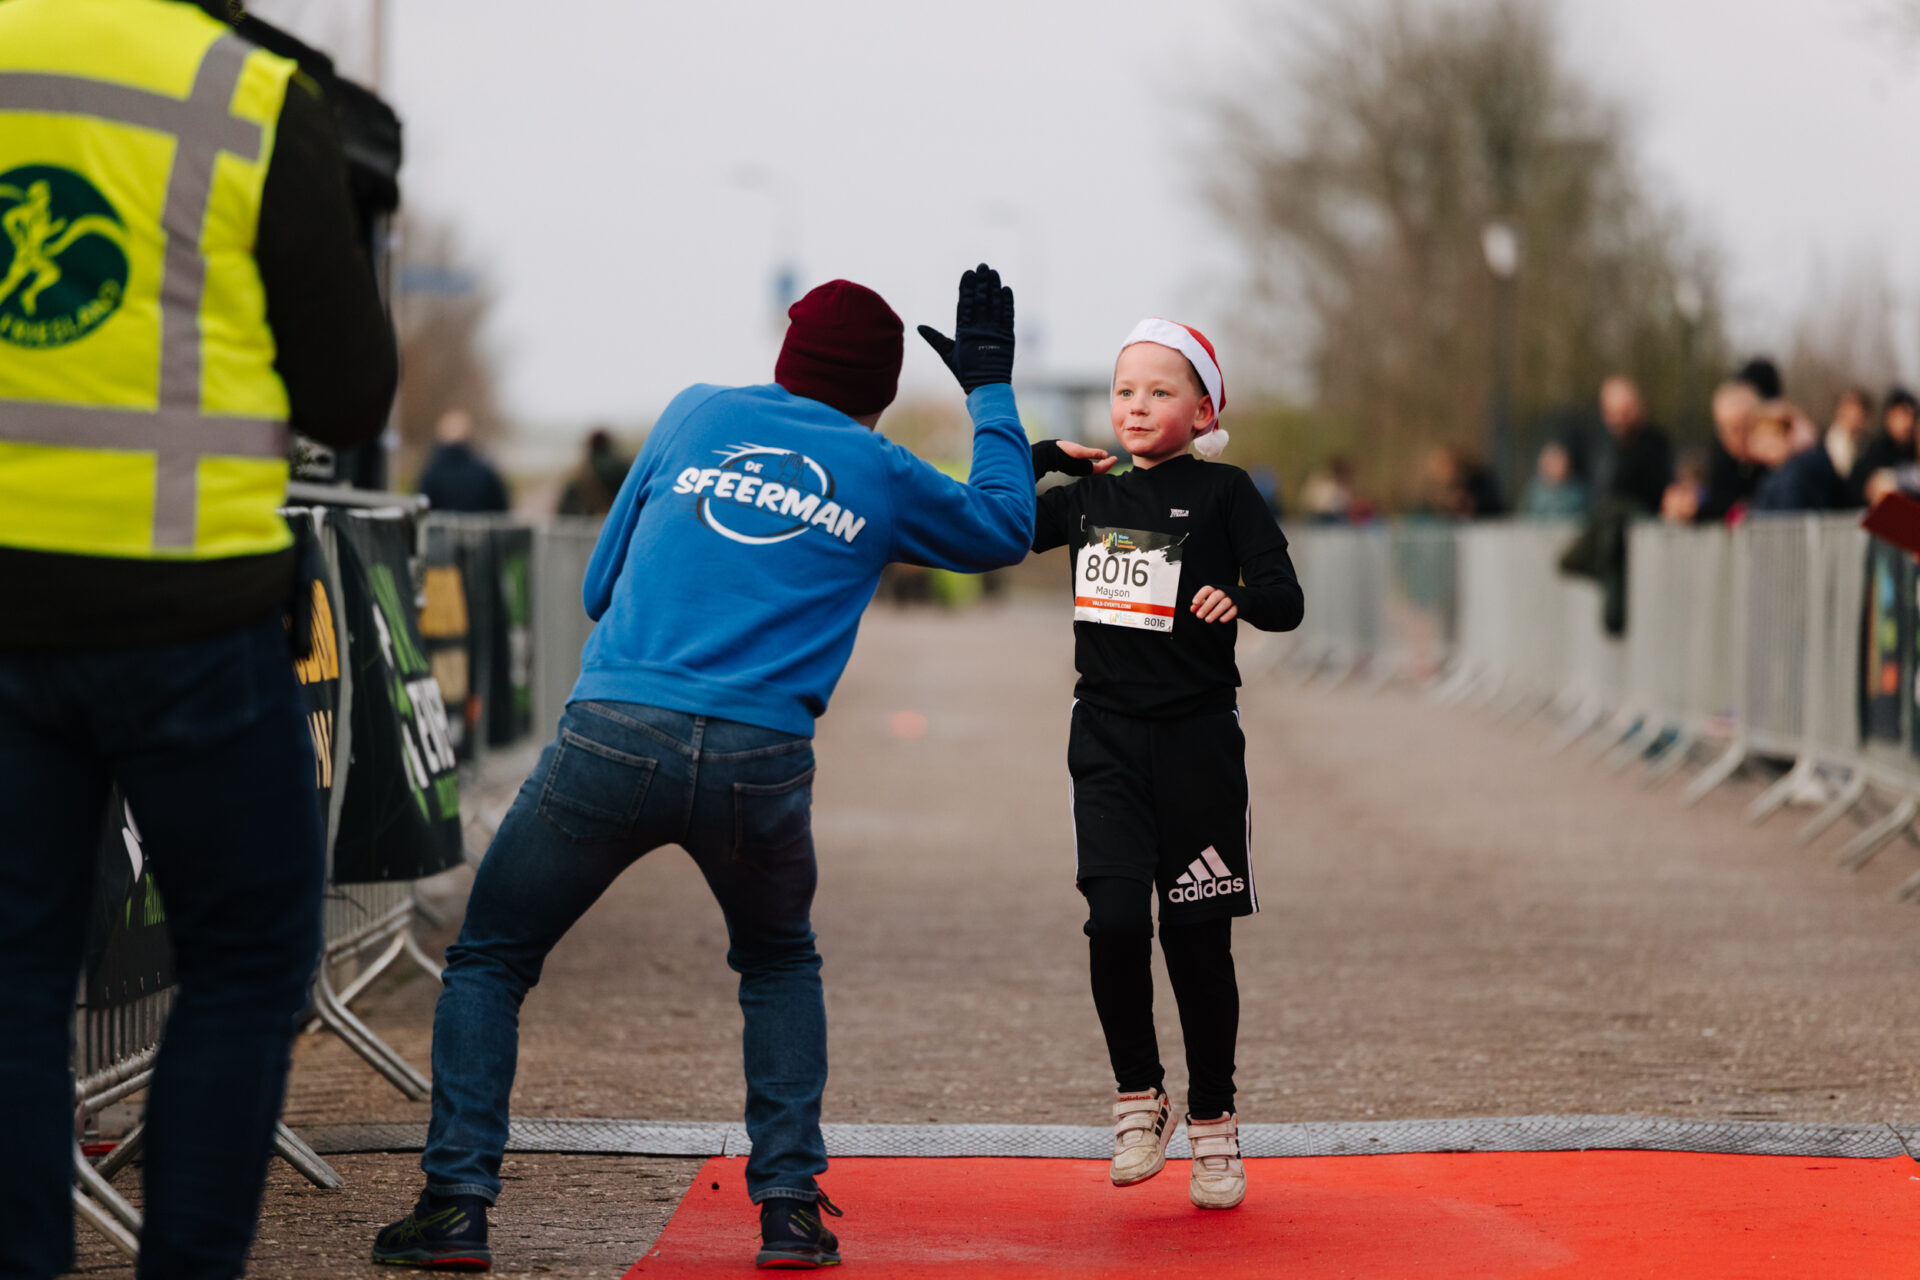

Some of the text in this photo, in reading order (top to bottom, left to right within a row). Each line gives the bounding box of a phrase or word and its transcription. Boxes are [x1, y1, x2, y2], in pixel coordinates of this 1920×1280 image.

[744, 461, 763, 473] DE
[672, 467, 866, 543] SFEERMAN
[1085, 554, 1150, 587] 8016
[1095, 586, 1130, 599] Mayson
[1144, 617, 1166, 628] 8016
[1168, 877, 1245, 903] adidas
